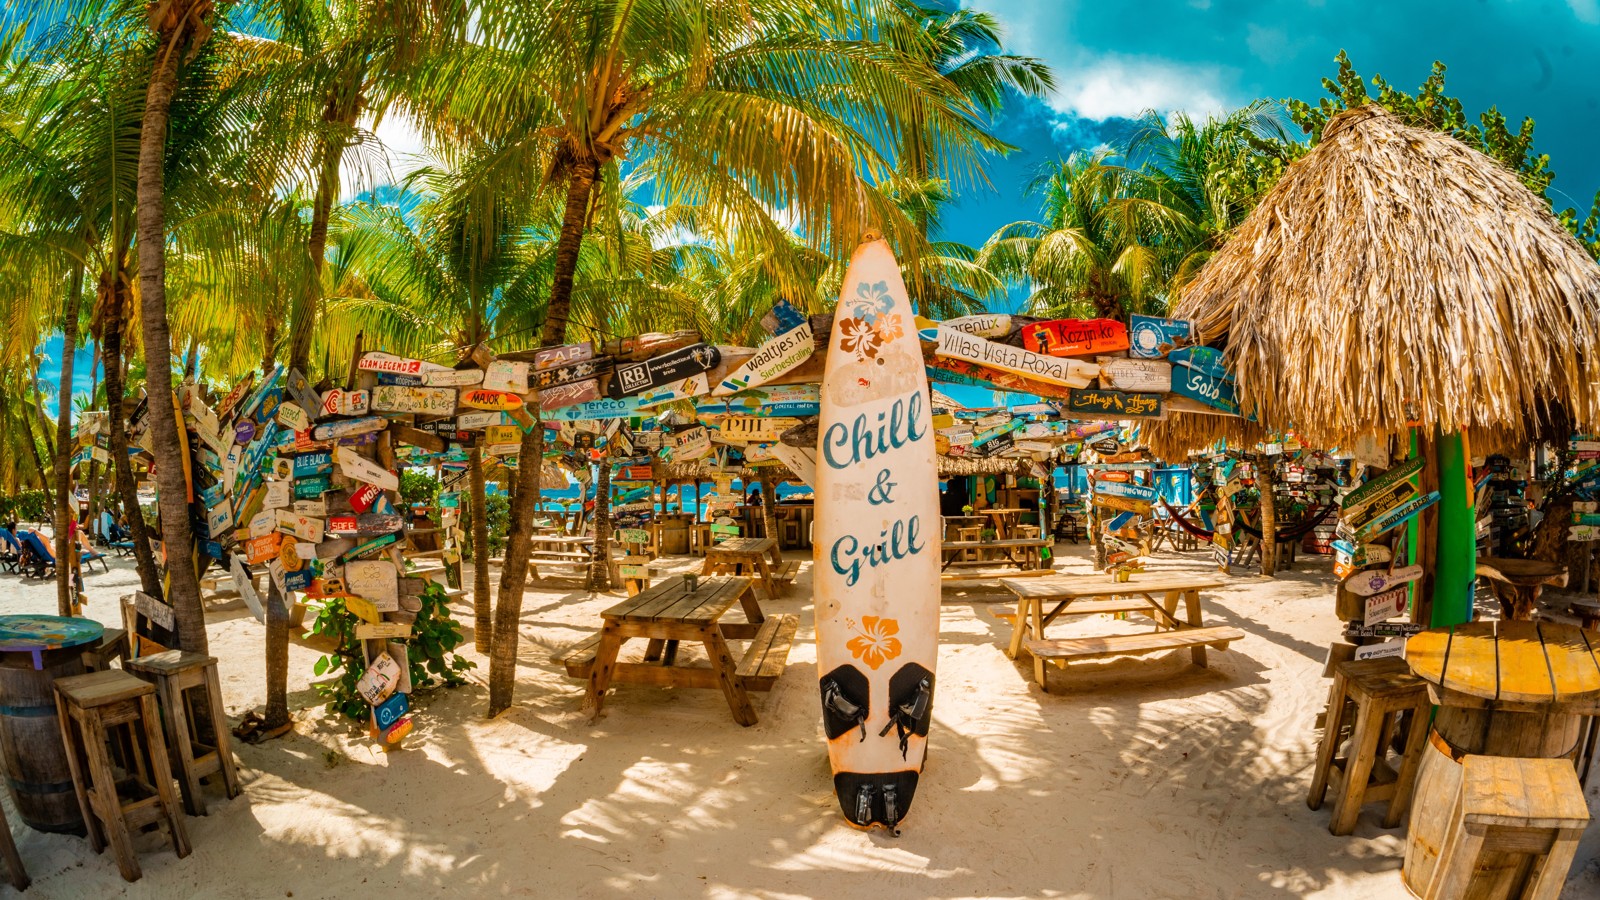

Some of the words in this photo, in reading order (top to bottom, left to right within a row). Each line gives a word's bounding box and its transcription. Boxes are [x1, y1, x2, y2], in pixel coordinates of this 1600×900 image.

[746, 326, 809, 371] waaltjes.nl
[944, 333, 979, 358] Villas
[984, 342, 1017, 368] Vista
[1020, 351, 1068, 380] Royal
[622, 367, 646, 385] RB
[624, 380, 649, 390] COLLECTION
[1186, 376, 1218, 400] Solo
[823, 390, 927, 469] Chill
[296, 455, 310, 468] BLUE
[310, 453, 327, 466] BLACK
[868, 468, 895, 506] &
[830, 514, 925, 587] Grill
